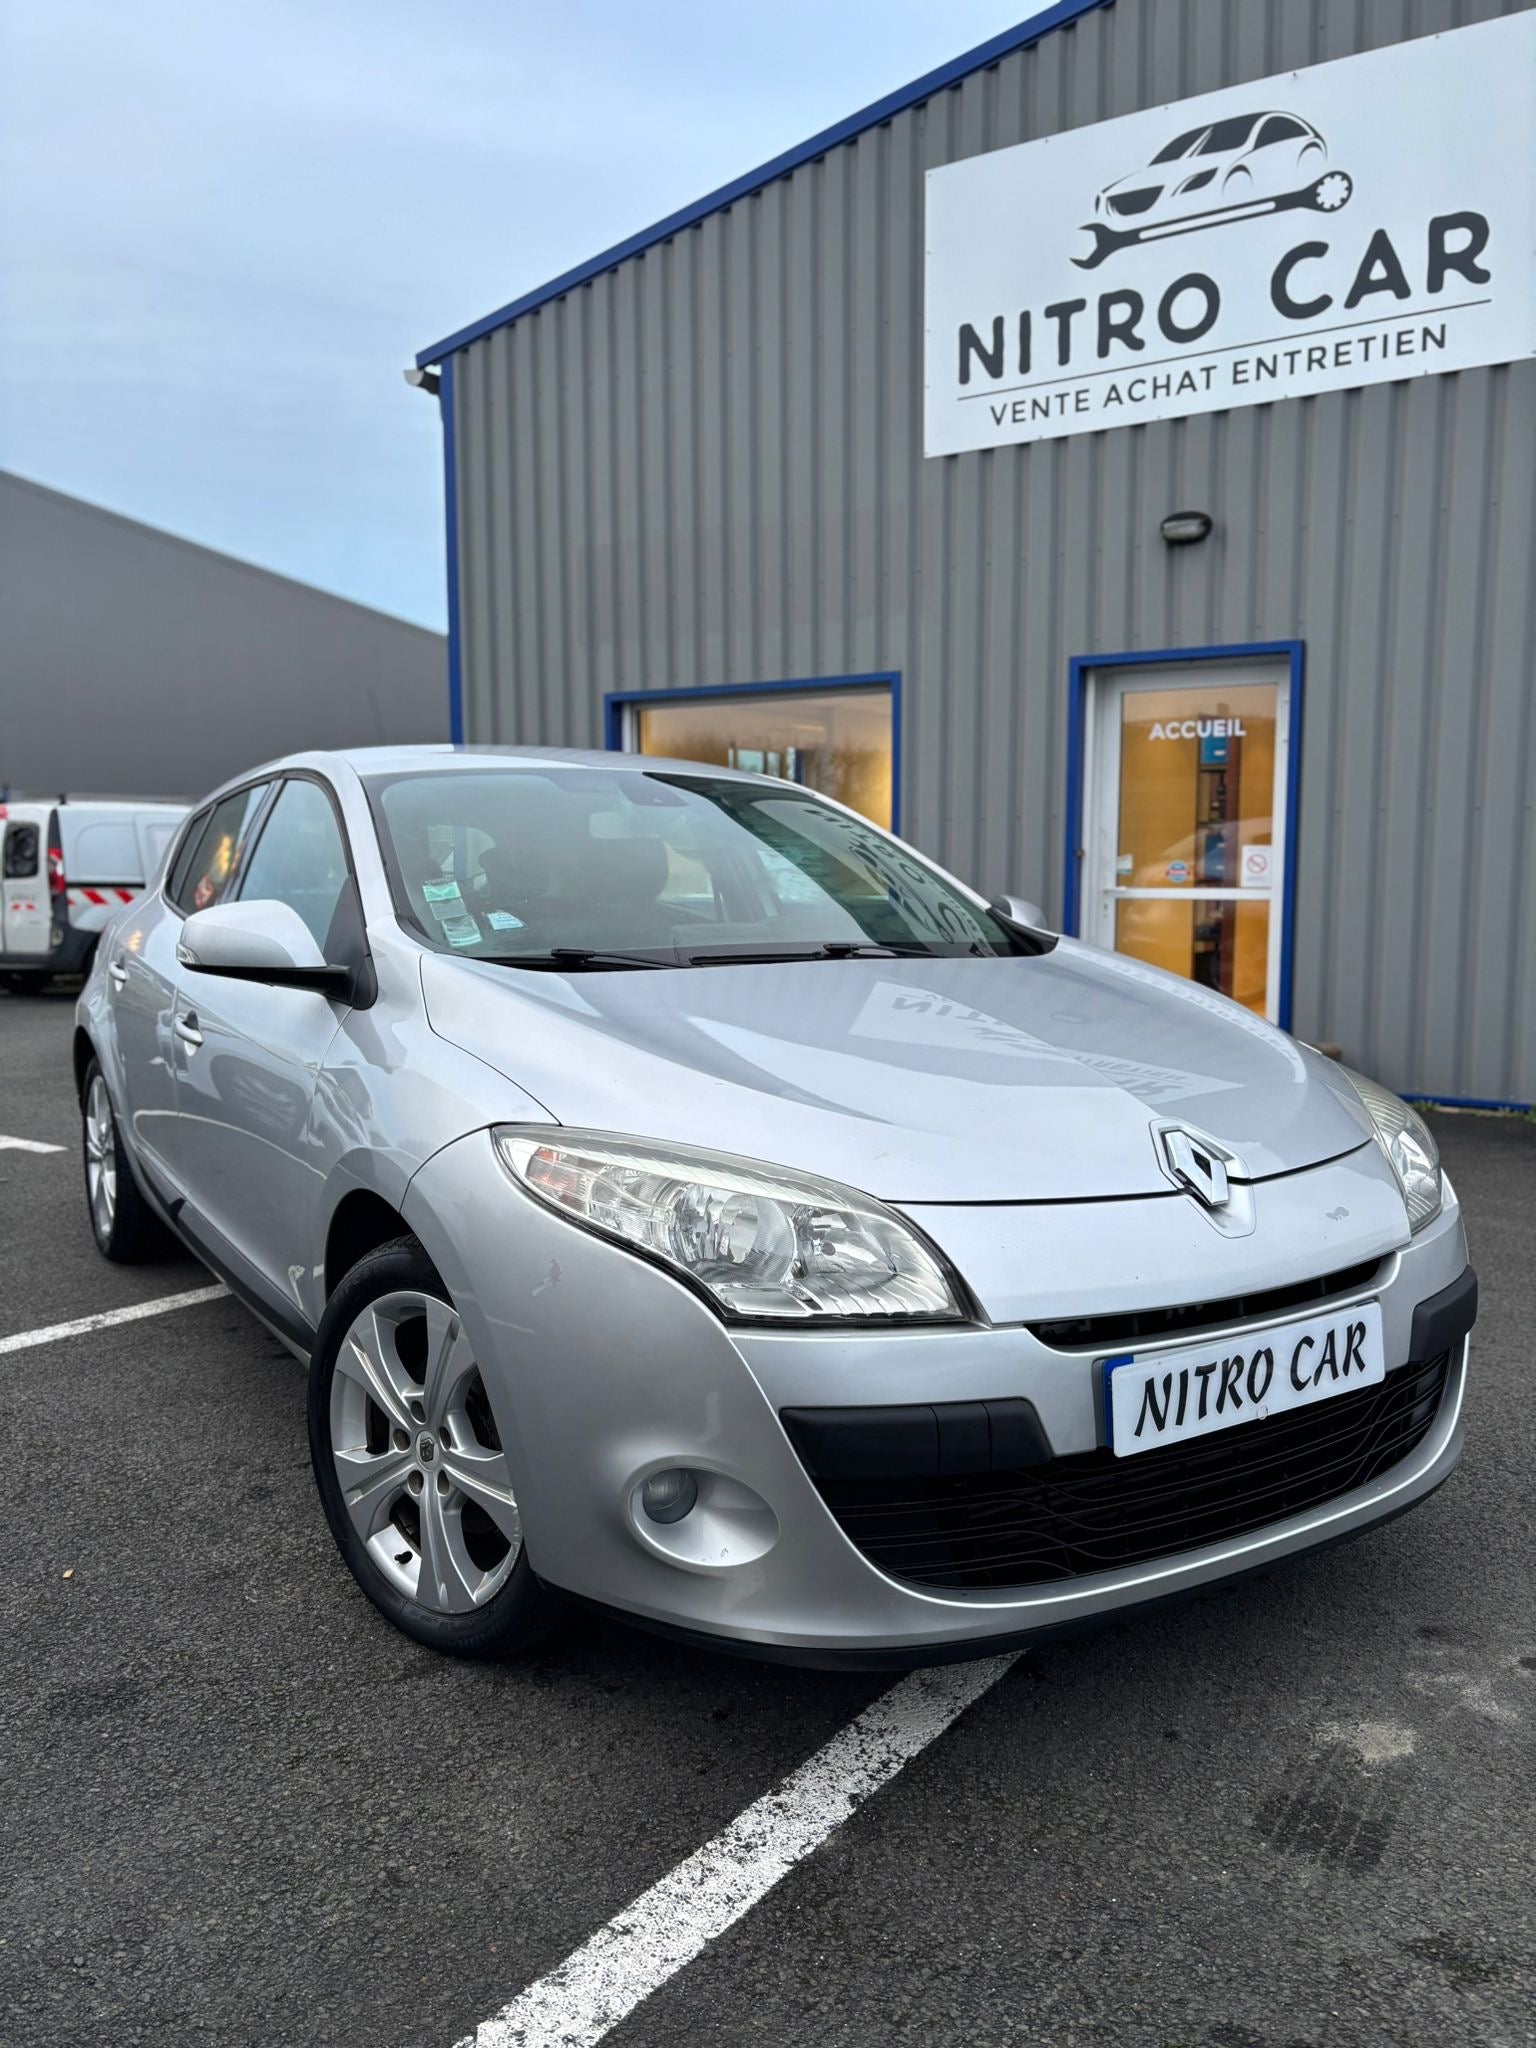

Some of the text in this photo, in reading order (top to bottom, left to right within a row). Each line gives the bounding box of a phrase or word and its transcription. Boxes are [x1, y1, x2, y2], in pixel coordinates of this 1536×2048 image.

[958, 211, 1492, 385] NITRO CAR
[990, 324, 1447, 427] VENTE ACHAT ENTRETIEN
[1149, 718, 1247, 740] ACCUEIL
[1134, 1321, 1366, 1437] NITRO CAR
